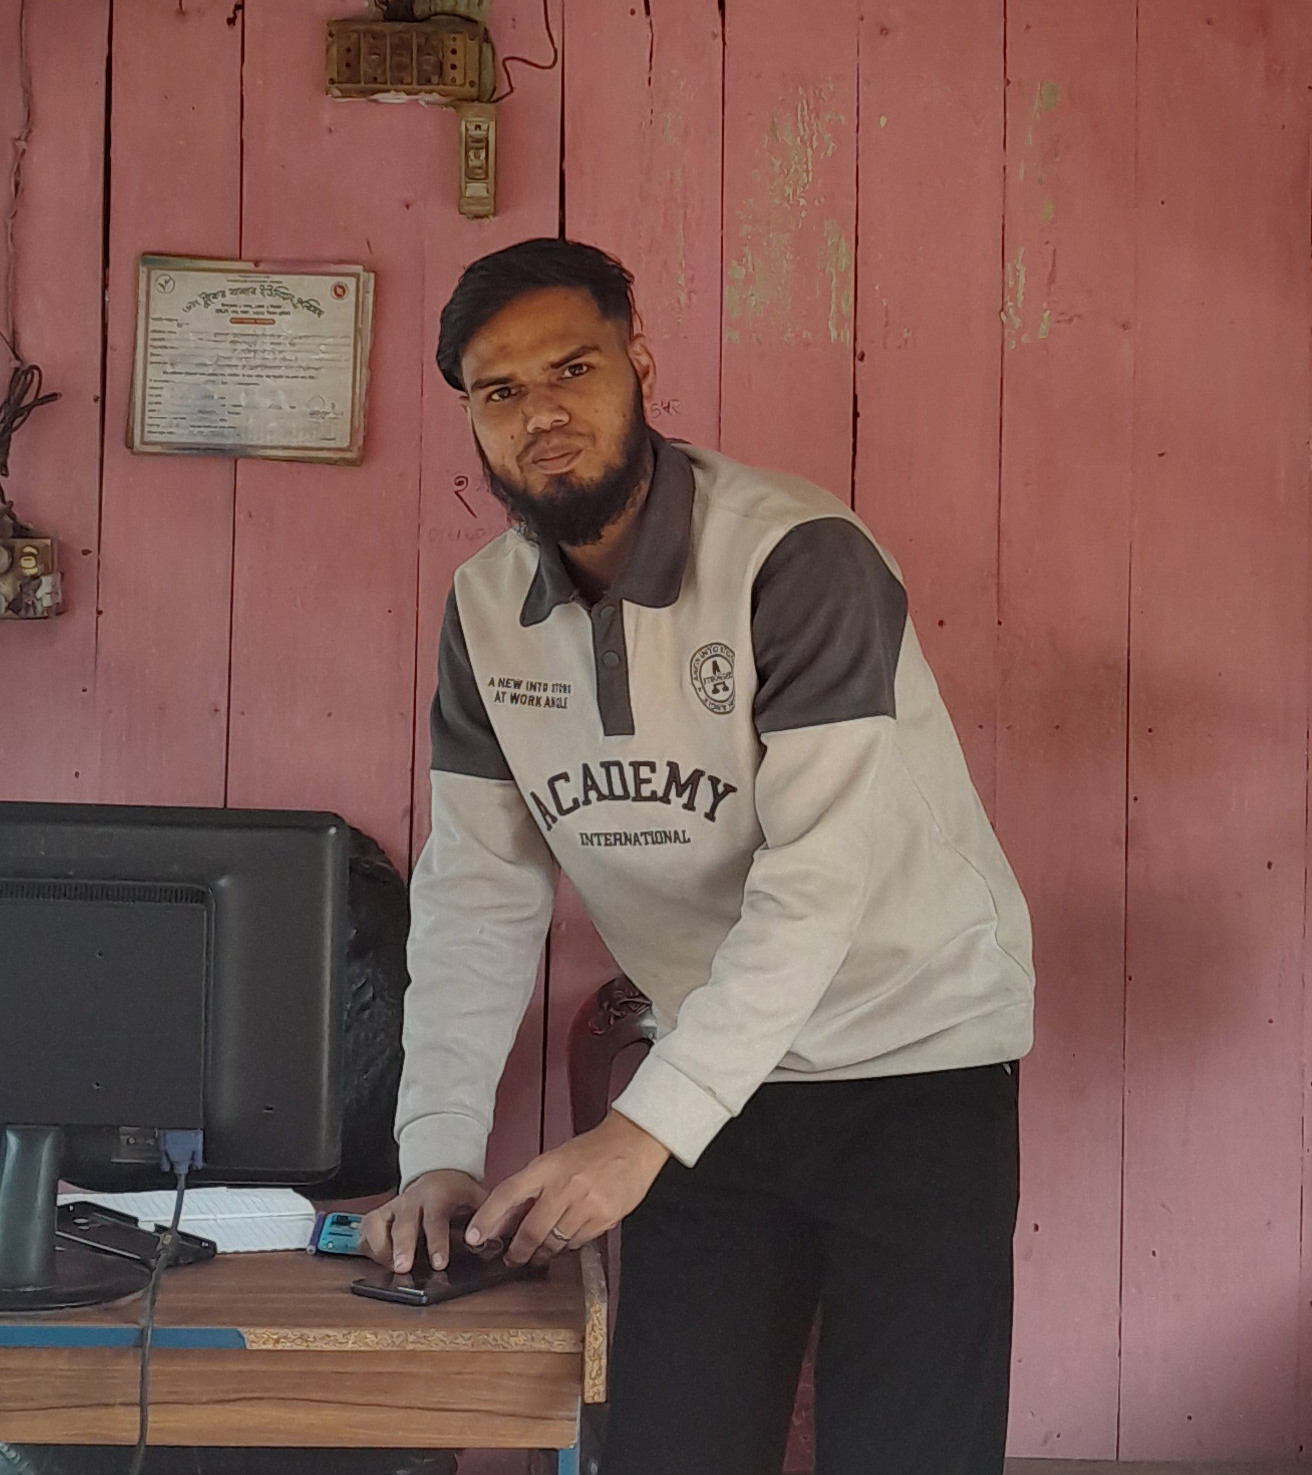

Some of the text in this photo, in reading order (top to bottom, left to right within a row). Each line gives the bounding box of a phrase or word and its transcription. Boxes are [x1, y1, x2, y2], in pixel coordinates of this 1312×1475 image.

[497, 677, 524, 690] NEW
[494, 690, 507, 704] AT
[510, 691, 543, 708] WORK
[530, 760, 738, 832] ACADEMY
[579, 828, 692, 847] INTERNATIONAL
